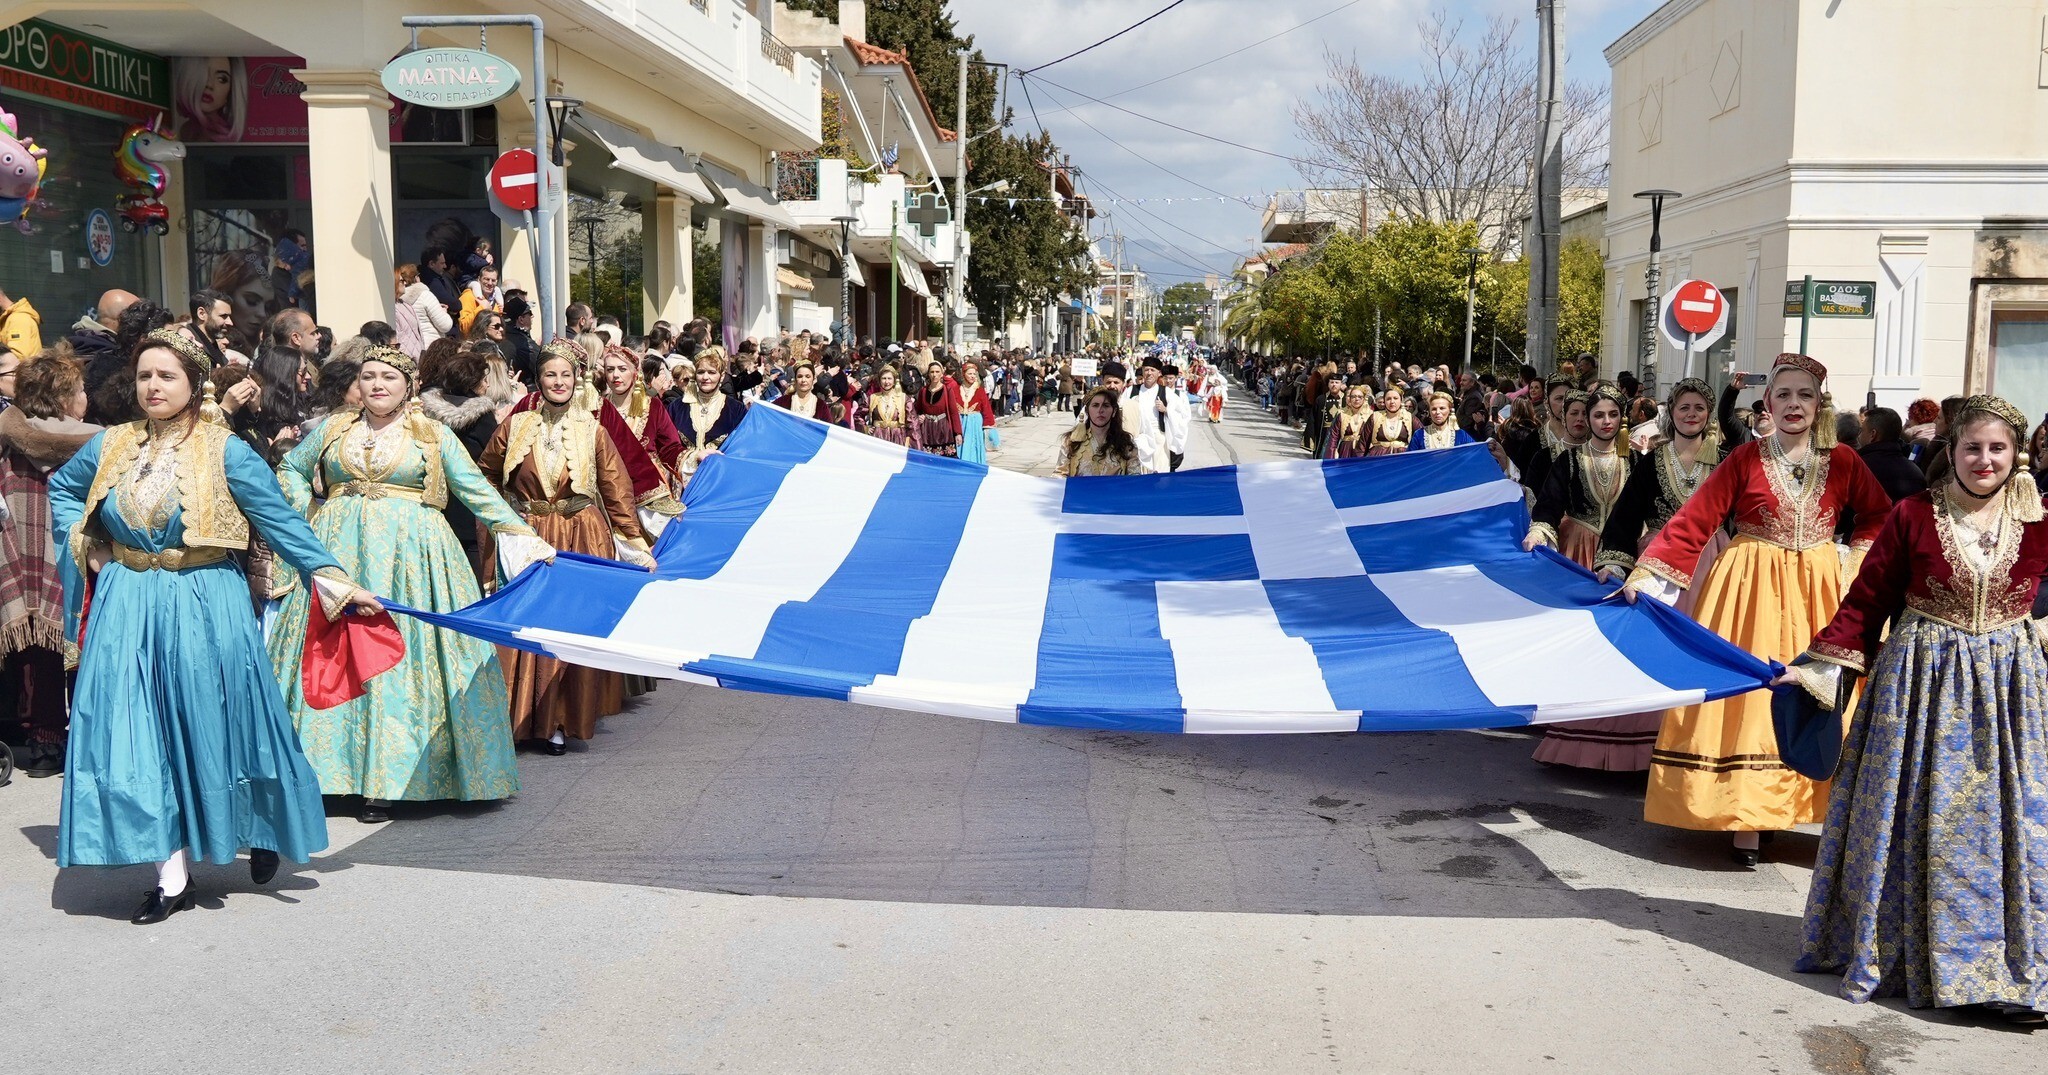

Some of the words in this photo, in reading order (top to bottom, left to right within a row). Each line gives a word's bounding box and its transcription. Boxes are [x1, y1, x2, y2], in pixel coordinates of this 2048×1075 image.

[425, 53, 470, 63] ΟΠΤΙΚΑ
[2, 70, 50, 92] ΠΤΙΚΑ
[398, 66, 500, 87] ΜΑΤΝΑΣ
[405, 89, 442, 101] ΦΑΚΟΙ
[446, 86, 495, 101] ΕΠΑΦΗΣ
[1829, 285, 1860, 294] ΟΔΟΣ
[1821, 305, 1837, 313] VAS.
[1838, 305, 1864, 314] SOFIAS
